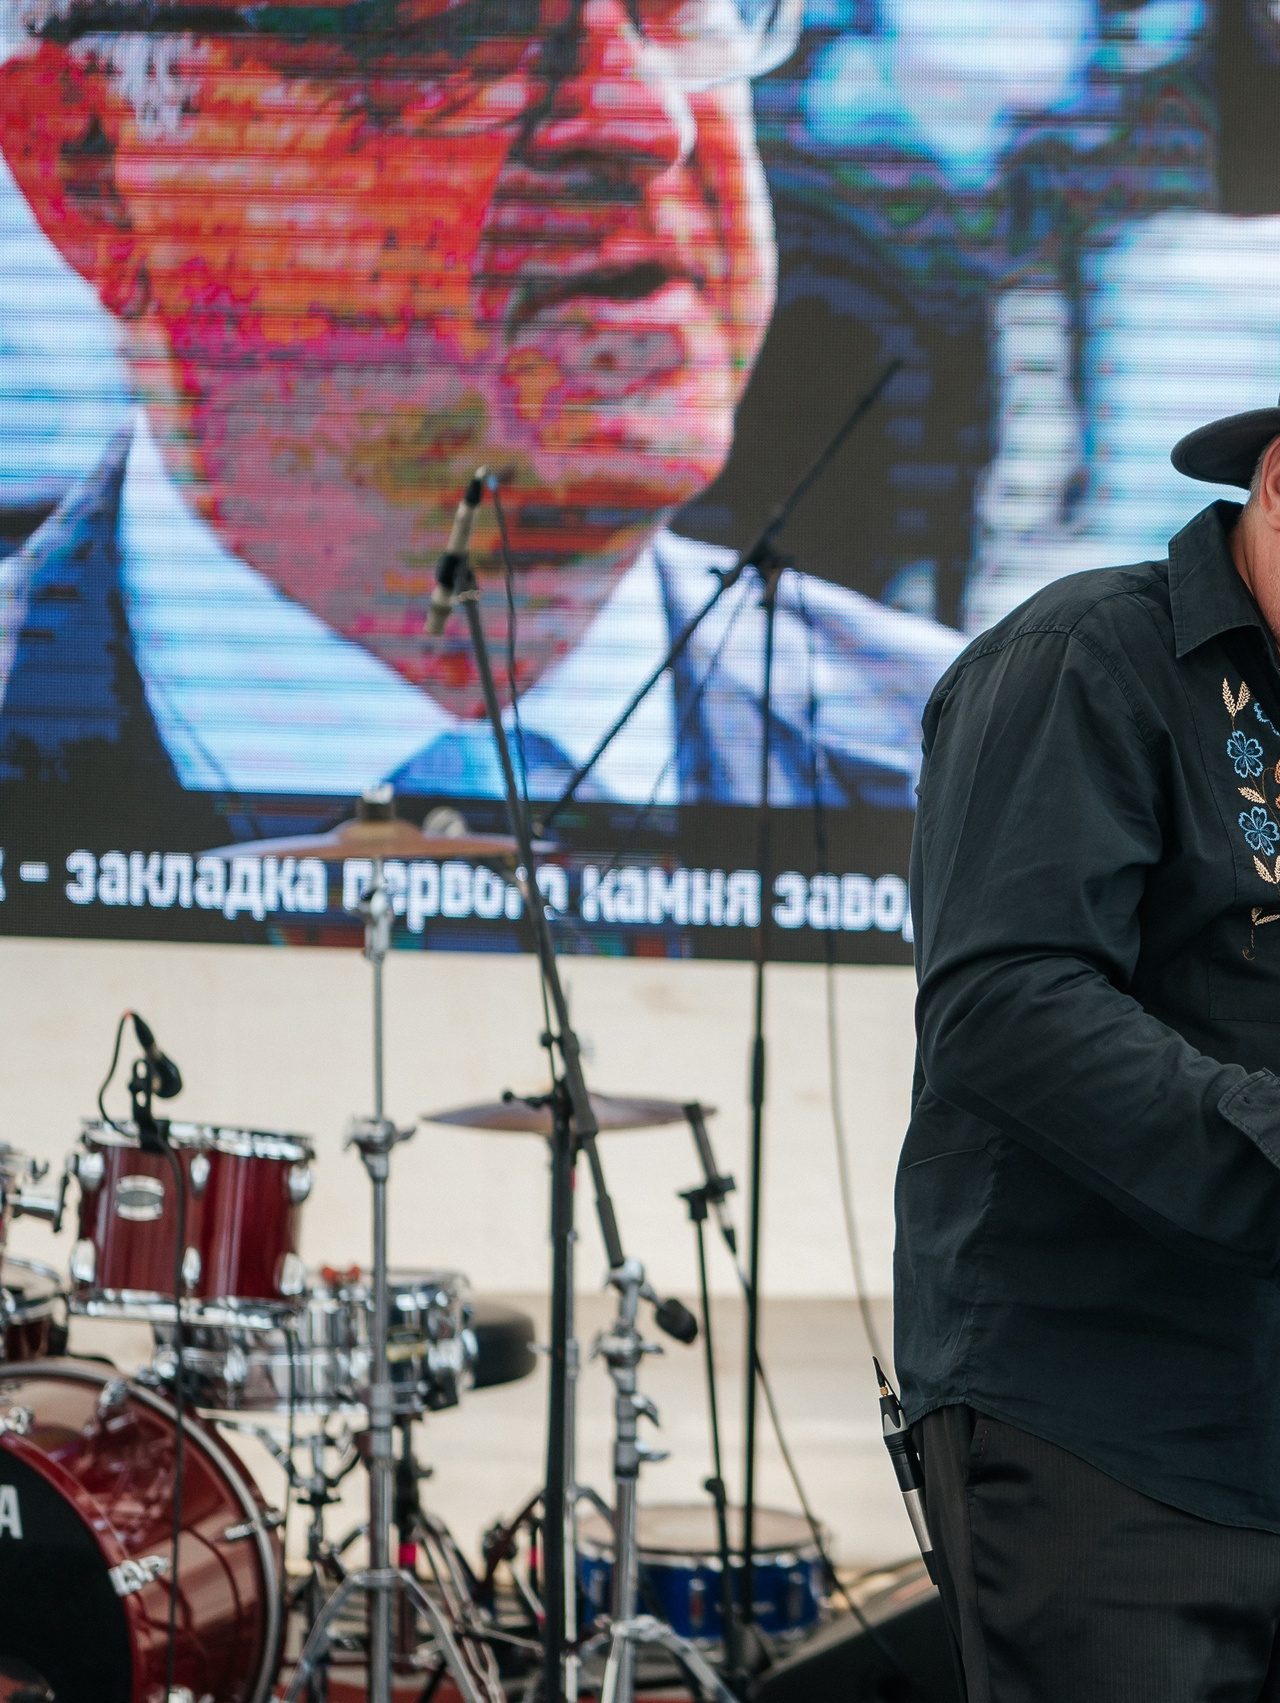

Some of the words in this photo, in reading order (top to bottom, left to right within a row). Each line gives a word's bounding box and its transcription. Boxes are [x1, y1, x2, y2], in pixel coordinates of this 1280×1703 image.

[65, 849, 328, 921] закладка
[582, 864, 762, 927] камня
[772, 871, 914, 943] заво
